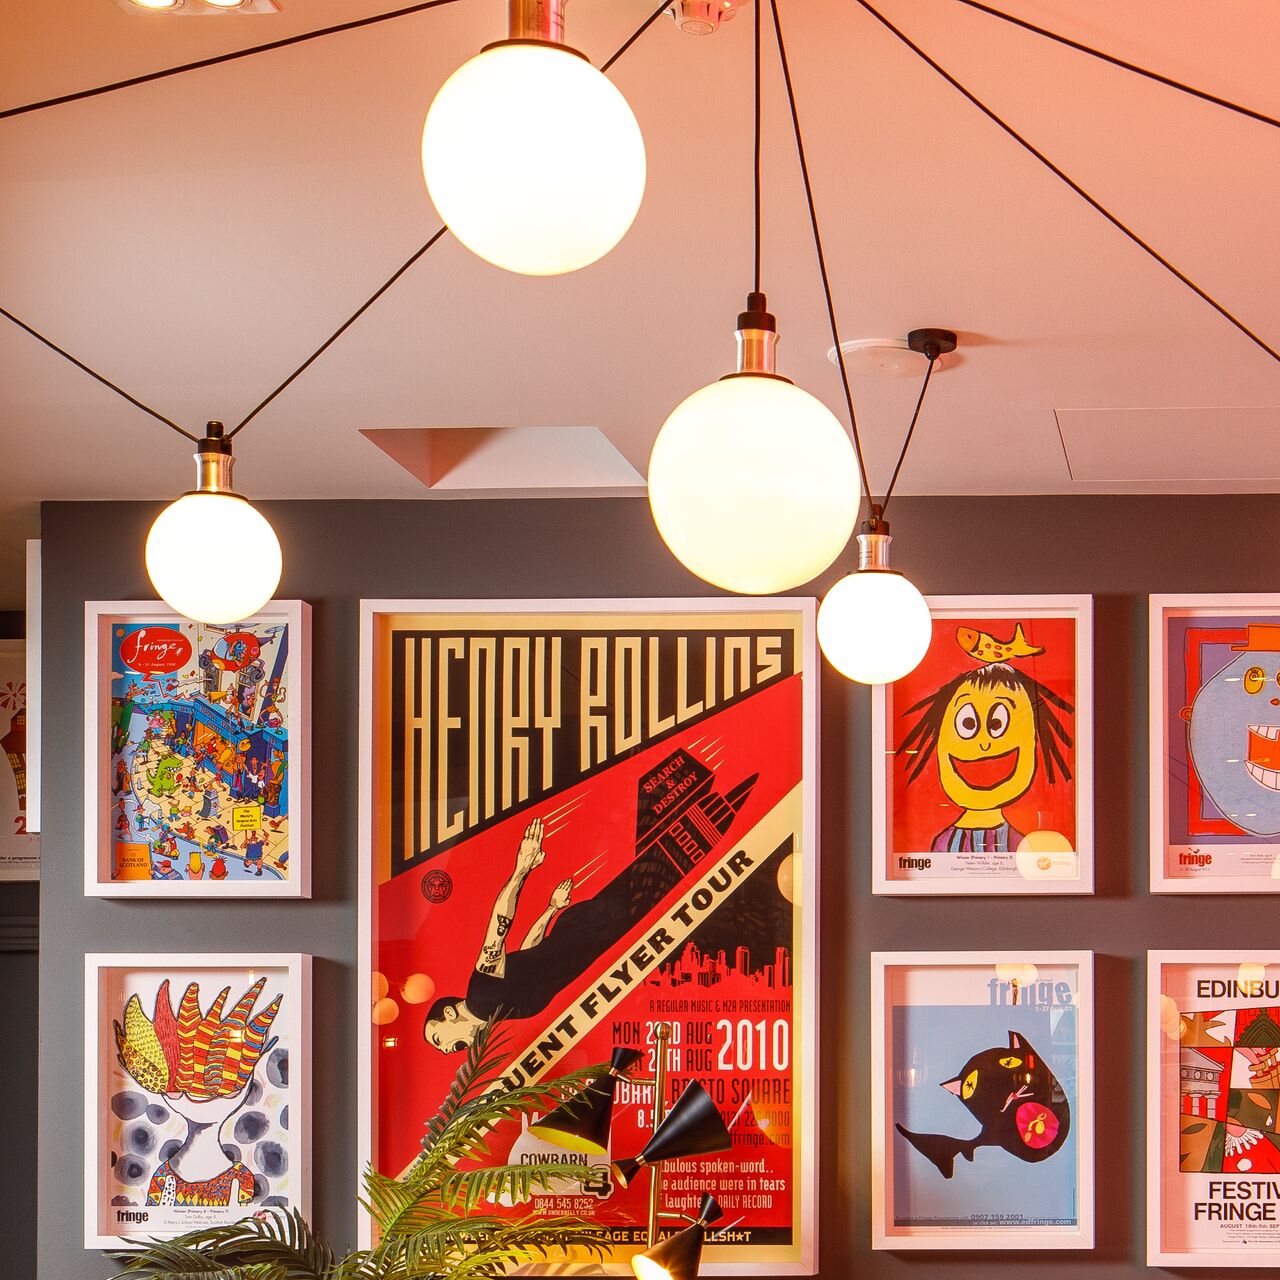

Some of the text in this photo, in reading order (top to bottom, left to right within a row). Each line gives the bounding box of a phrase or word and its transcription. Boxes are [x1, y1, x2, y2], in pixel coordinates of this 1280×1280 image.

[404, 636, 782, 861] HENRY ROLLINS
[643, 755, 686, 794] SEARCH
[665, 777, 676, 789] &
[651, 771, 699, 816] DESTROY
[898, 856, 932, 871] fringe
[1178, 852, 1212, 867] fringe
[579, 927, 676, 1020] FLYER
[670, 849, 755, 927] TOUR
[650, 1000, 791, 1012] A REGULAR MUSIC & MZA PRESENTATION
[612, 1021, 641, 1045] MON
[686, 1021, 713, 1045] AUG
[716, 1018, 790, 1071] 2010
[648, 1049, 681, 1072] 2TH
[686, 1049, 713, 1072] AUG
[731, 1078, 790, 1104] SQUARE
[661, 1158, 698, 1173] bulous
[671, 1177, 717, 1191] audience
[719, 1180, 744, 1191] were
[746, 1177, 757, 1190] in
[759, 1177, 786, 1190] tears
[534, 1197, 594, 1210] 0844 545 8252
[742, 1195, 773, 1208] RECORD
[117, 1210, 149, 1223] fringe
[1194, 1202, 1277, 1221] FRINGE
[999, 1218, 1072, 1226] www.edfringe.com
